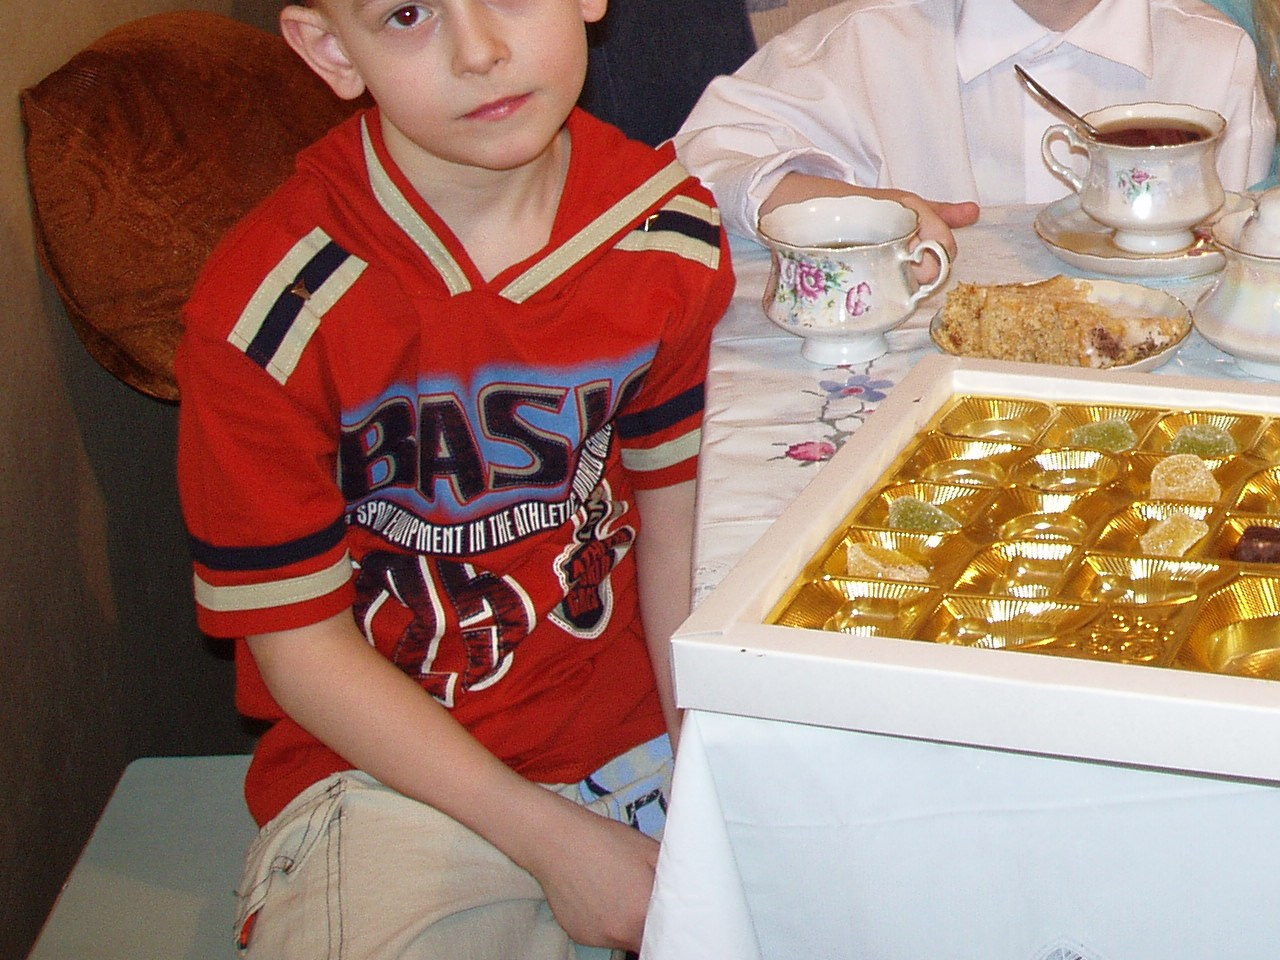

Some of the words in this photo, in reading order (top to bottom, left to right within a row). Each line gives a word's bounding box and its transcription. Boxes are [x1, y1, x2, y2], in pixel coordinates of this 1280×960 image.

[382, 510, 464, 554] EQUIPMENT
[470, 520, 486, 553] IN
[488, 510, 516, 547] THE
